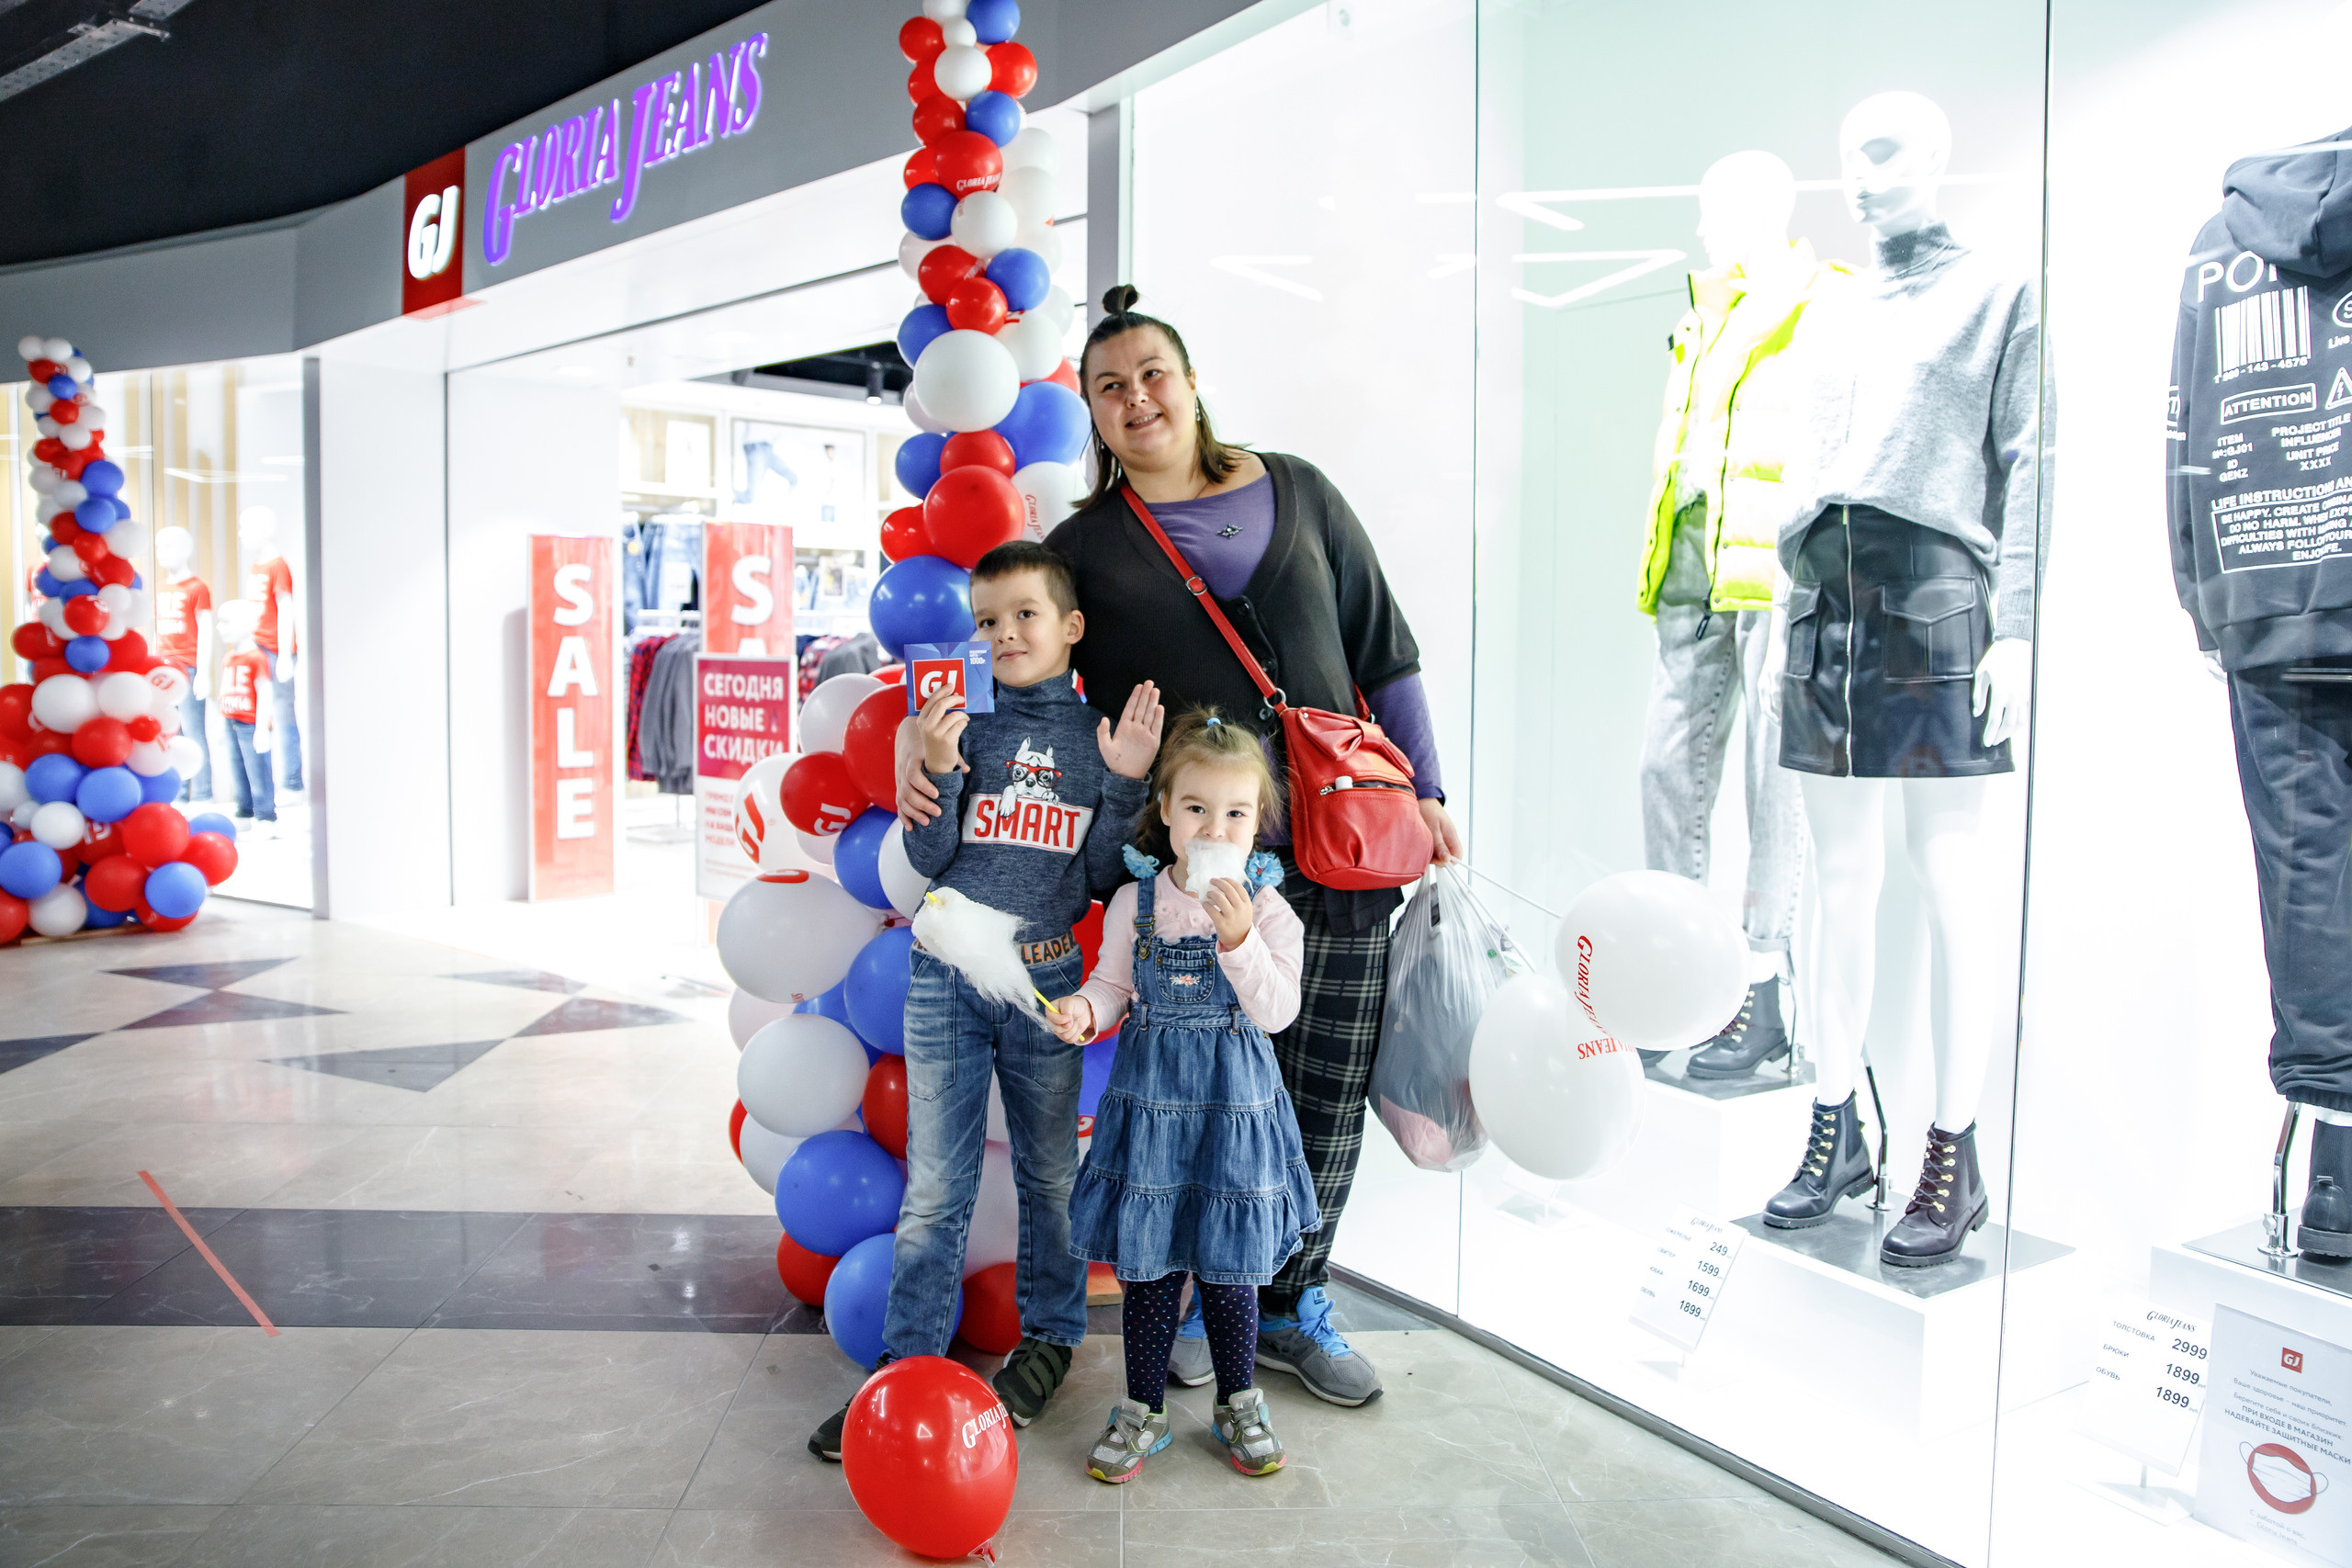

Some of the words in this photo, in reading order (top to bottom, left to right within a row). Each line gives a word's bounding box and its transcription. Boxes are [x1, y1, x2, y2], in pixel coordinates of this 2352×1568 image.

[483, 97, 620, 266] GLORIA
[609, 31, 769, 224] JEANS
[407, 185, 459, 280] GJ
[2224, 391, 2312, 417] ATTENTION
[2217, 433, 2245, 446] ITEM
[2271, 420, 2326, 437] PROJECT
[2286, 447, 2314, 461] UNIT
[2211, 495, 2236, 511] LIFE
[2221, 513, 2233, 525] BE
[2274, 502, 2320, 516] CREATE
[2220, 530, 2284, 547] DIFFICULTIES
[2286, 526, 2316, 539] WITH
[2243, 520, 2260, 531] NO
[2263, 515, 2301, 529] HARM.
[2238, 541, 2284, 555] ALWAYS
[704, 672, 784, 702] СЕГОДНЯ
[920, 670, 958, 699] GJ
[547, 563, 599, 840] SALE
[704, 704, 765, 732] НОВЫЕ
[814, 803, 852, 836] GJ
[974, 799, 1080, 849] SMART
[1577, 935, 1593, 999] GLORIA
[1710, 1241, 1728, 1257] 249
[1698, 1260, 1720, 1277] 1599
[1688, 1280, 1710, 1297] 1699
[1679, 1300, 1702, 1317] 1899
[2146, 1311, 2174, 1325] GLORIA
[2170, 1319, 2197, 1333] JEANS
[2113, 1321, 2155, 1342] ТОЛСТОВКА
[2172, 1338, 2208, 1359] 2999
[2103, 1343, 2130, 1359] БРЮКИ
[2165, 1363, 2200, 1384] 1899
[2283, 1353, 2301, 1368] GJ
[2096, 1366, 2120, 1381] ОБУВЬ
[2156, 1386, 2189, 1408] 1899
[2250, 1369, 2288, 1389] Уважаемые
[2233, 1378, 2251, 1389] Ваше
[2253, 1385, 2284, 1402] здоровье
[2291, 1402, 2306, 1410] наш
[2233, 1393, 2265, 1409] Берегите
[2266, 1405, 2281, 1416] себя
[2290, 1415, 2310, 1427] своих
[962, 1406, 1001, 1450] GLORIA
[2224, 1408, 2270, 1432] НАДЕВАЙТЕ
[2271, 1427, 2318, 1451] ЗАЩИТНЫЕ
[2320, 1447, 2351, 1465] МАСКИ
[2242, 1405, 2258, 1416] ПРИ
[2260, 1412, 2286, 1427] ВХОДЕ
[2294, 1426, 2334, 1447] МАГАЗИН
